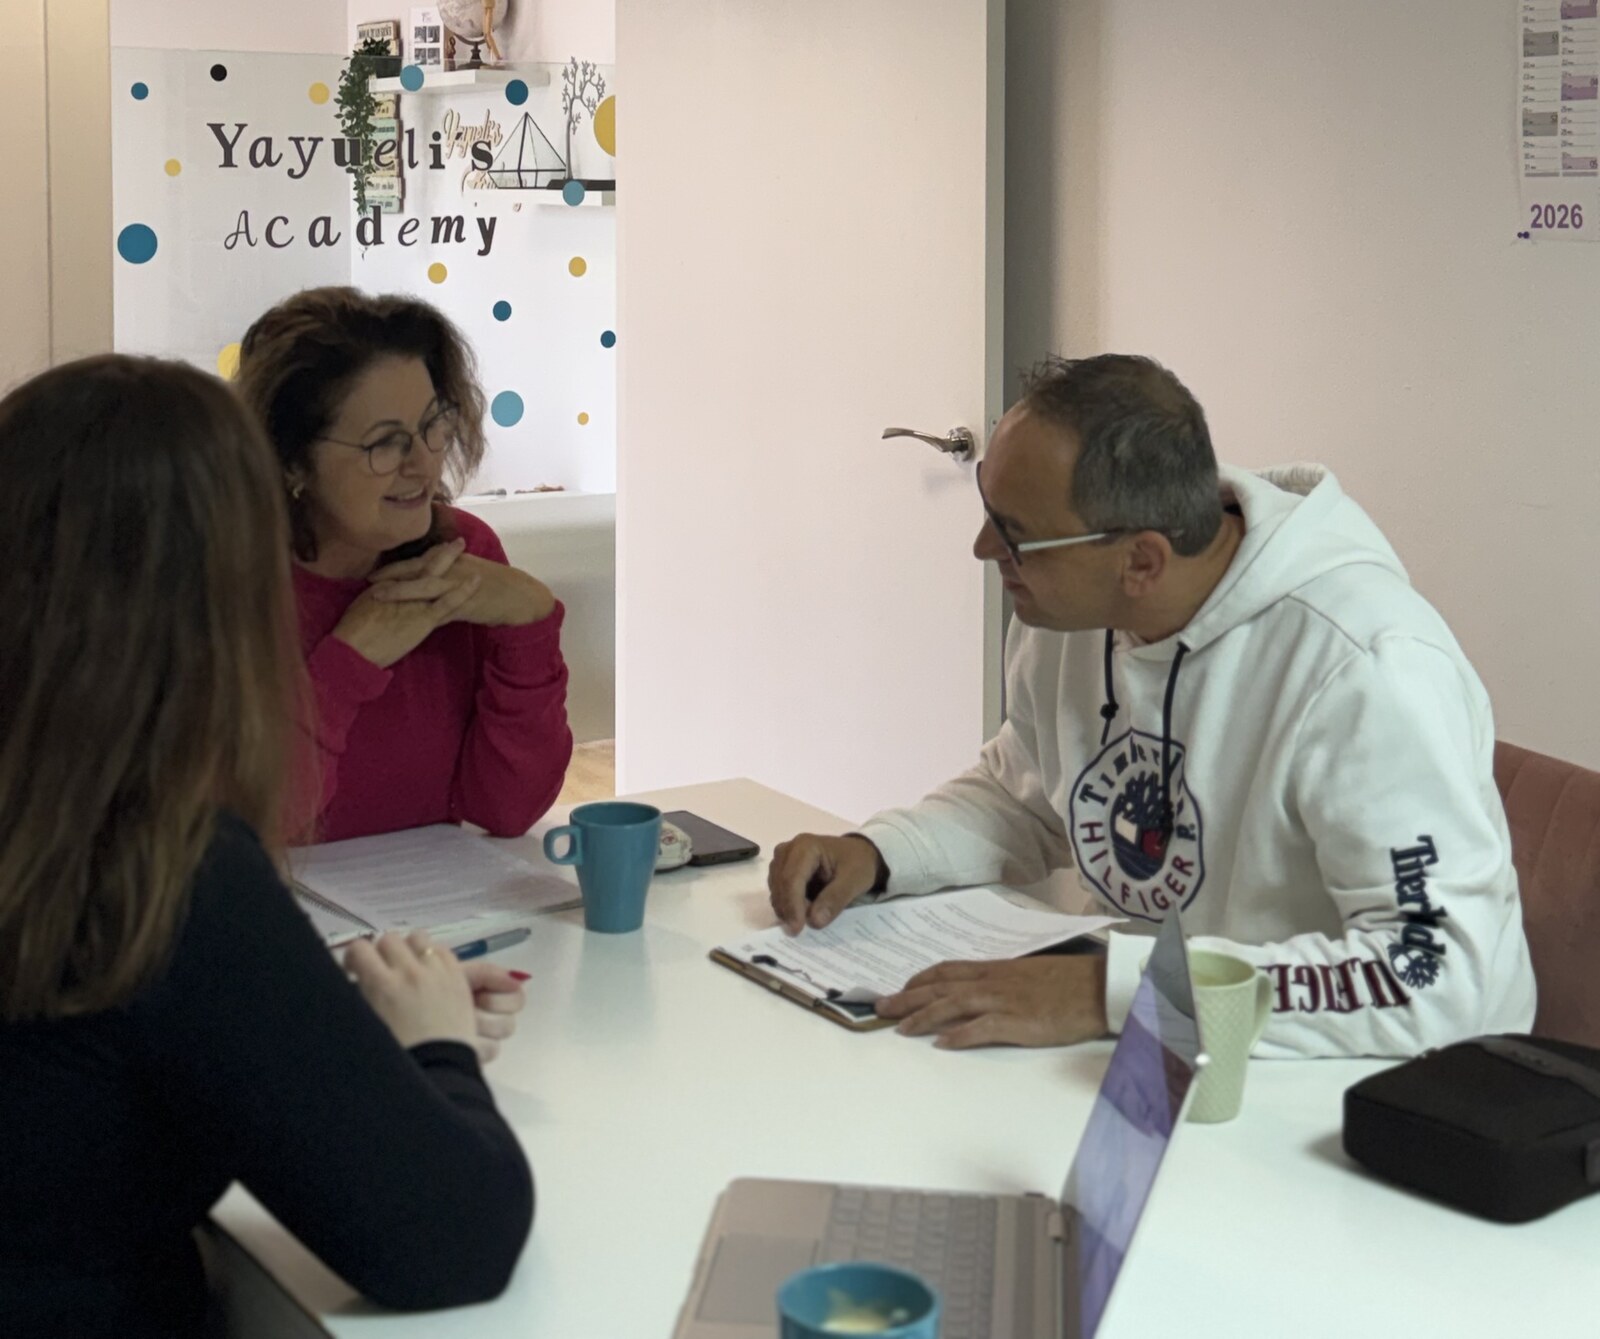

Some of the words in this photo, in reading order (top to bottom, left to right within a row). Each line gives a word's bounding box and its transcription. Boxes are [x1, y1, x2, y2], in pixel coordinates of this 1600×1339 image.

[206, 123, 494, 179] Yayueli's
[222, 205, 497, 256] Academy
[1530, 204, 1583, 229] 2026
[1079, 821, 1195, 914] HILFIGER
